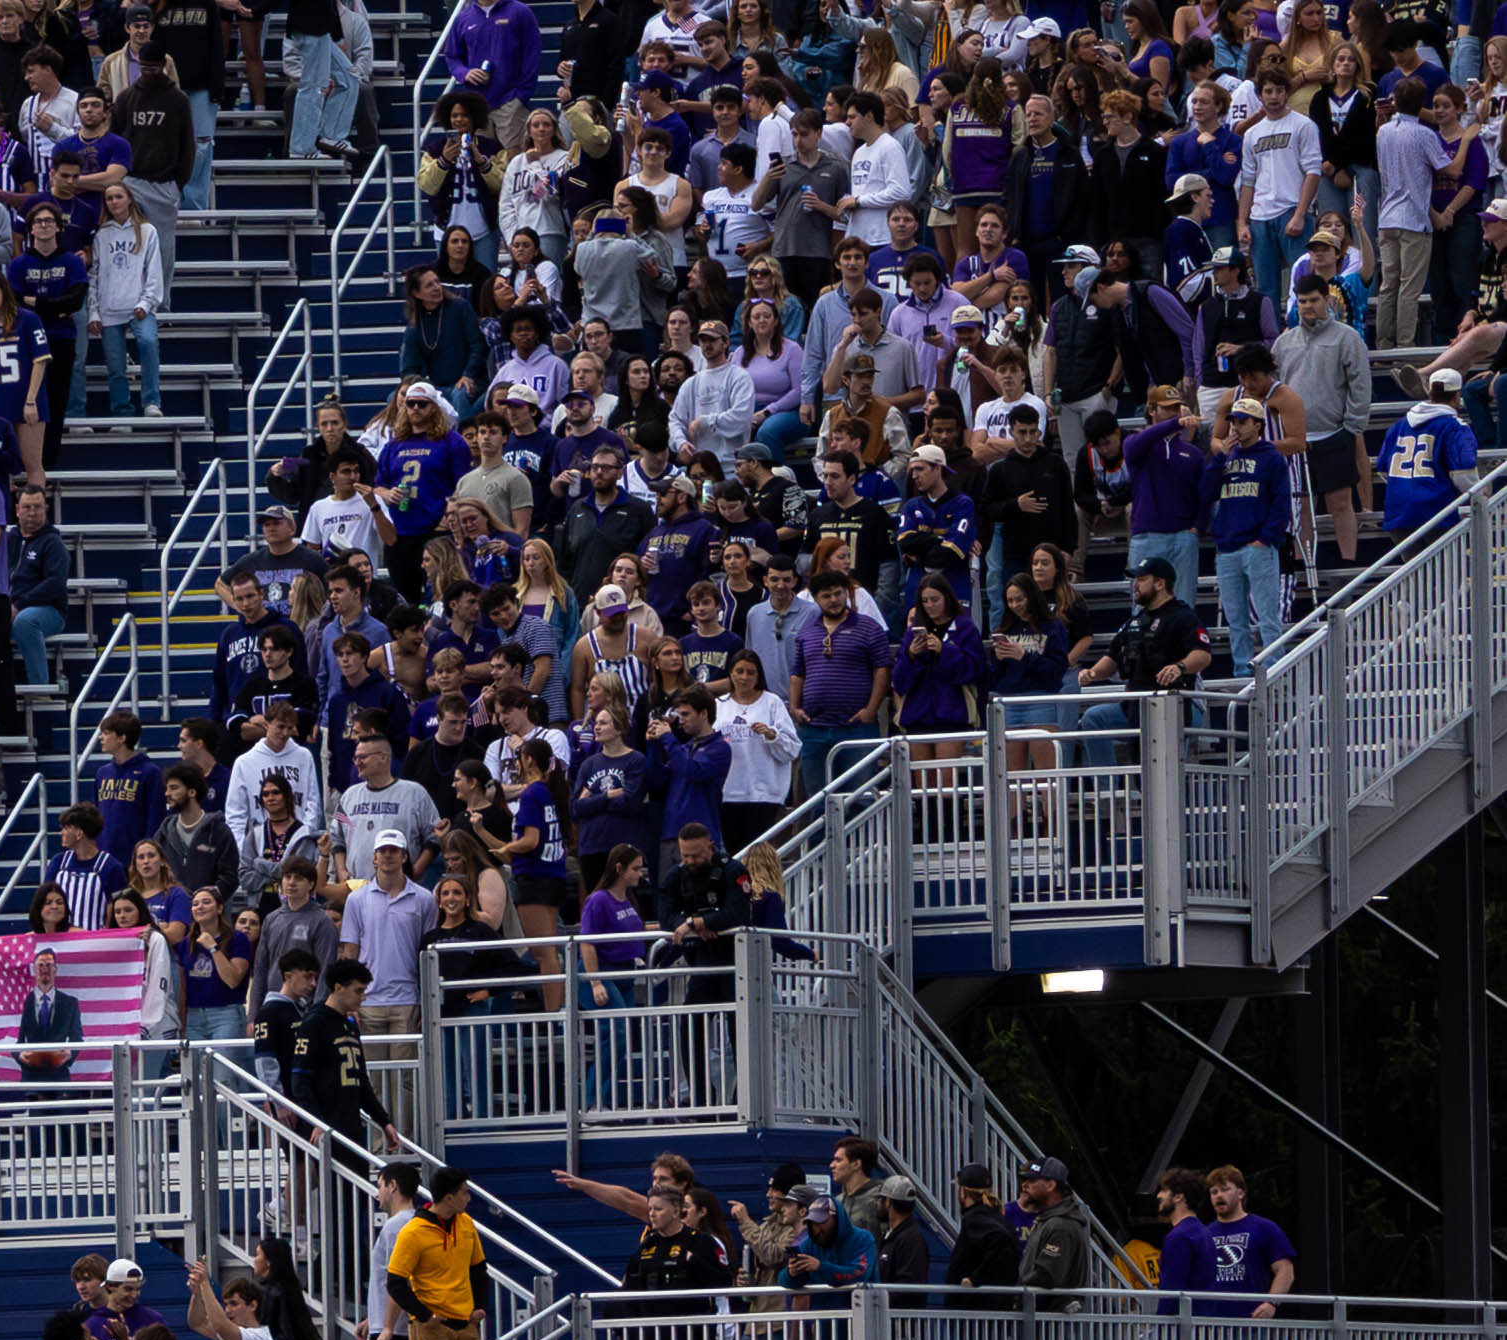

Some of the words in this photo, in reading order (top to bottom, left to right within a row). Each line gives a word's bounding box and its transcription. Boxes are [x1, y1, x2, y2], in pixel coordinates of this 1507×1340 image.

[133, 112, 166, 125] 1977
[1233, 105, 1246, 118] 25
[1253, 133, 1291, 154] JMU
[1390, 436, 1434, 478] 22
[261, 769, 299, 782] JAMES
[255, 1023, 268, 1039] 25
[294, 1038, 309, 1054] 25
